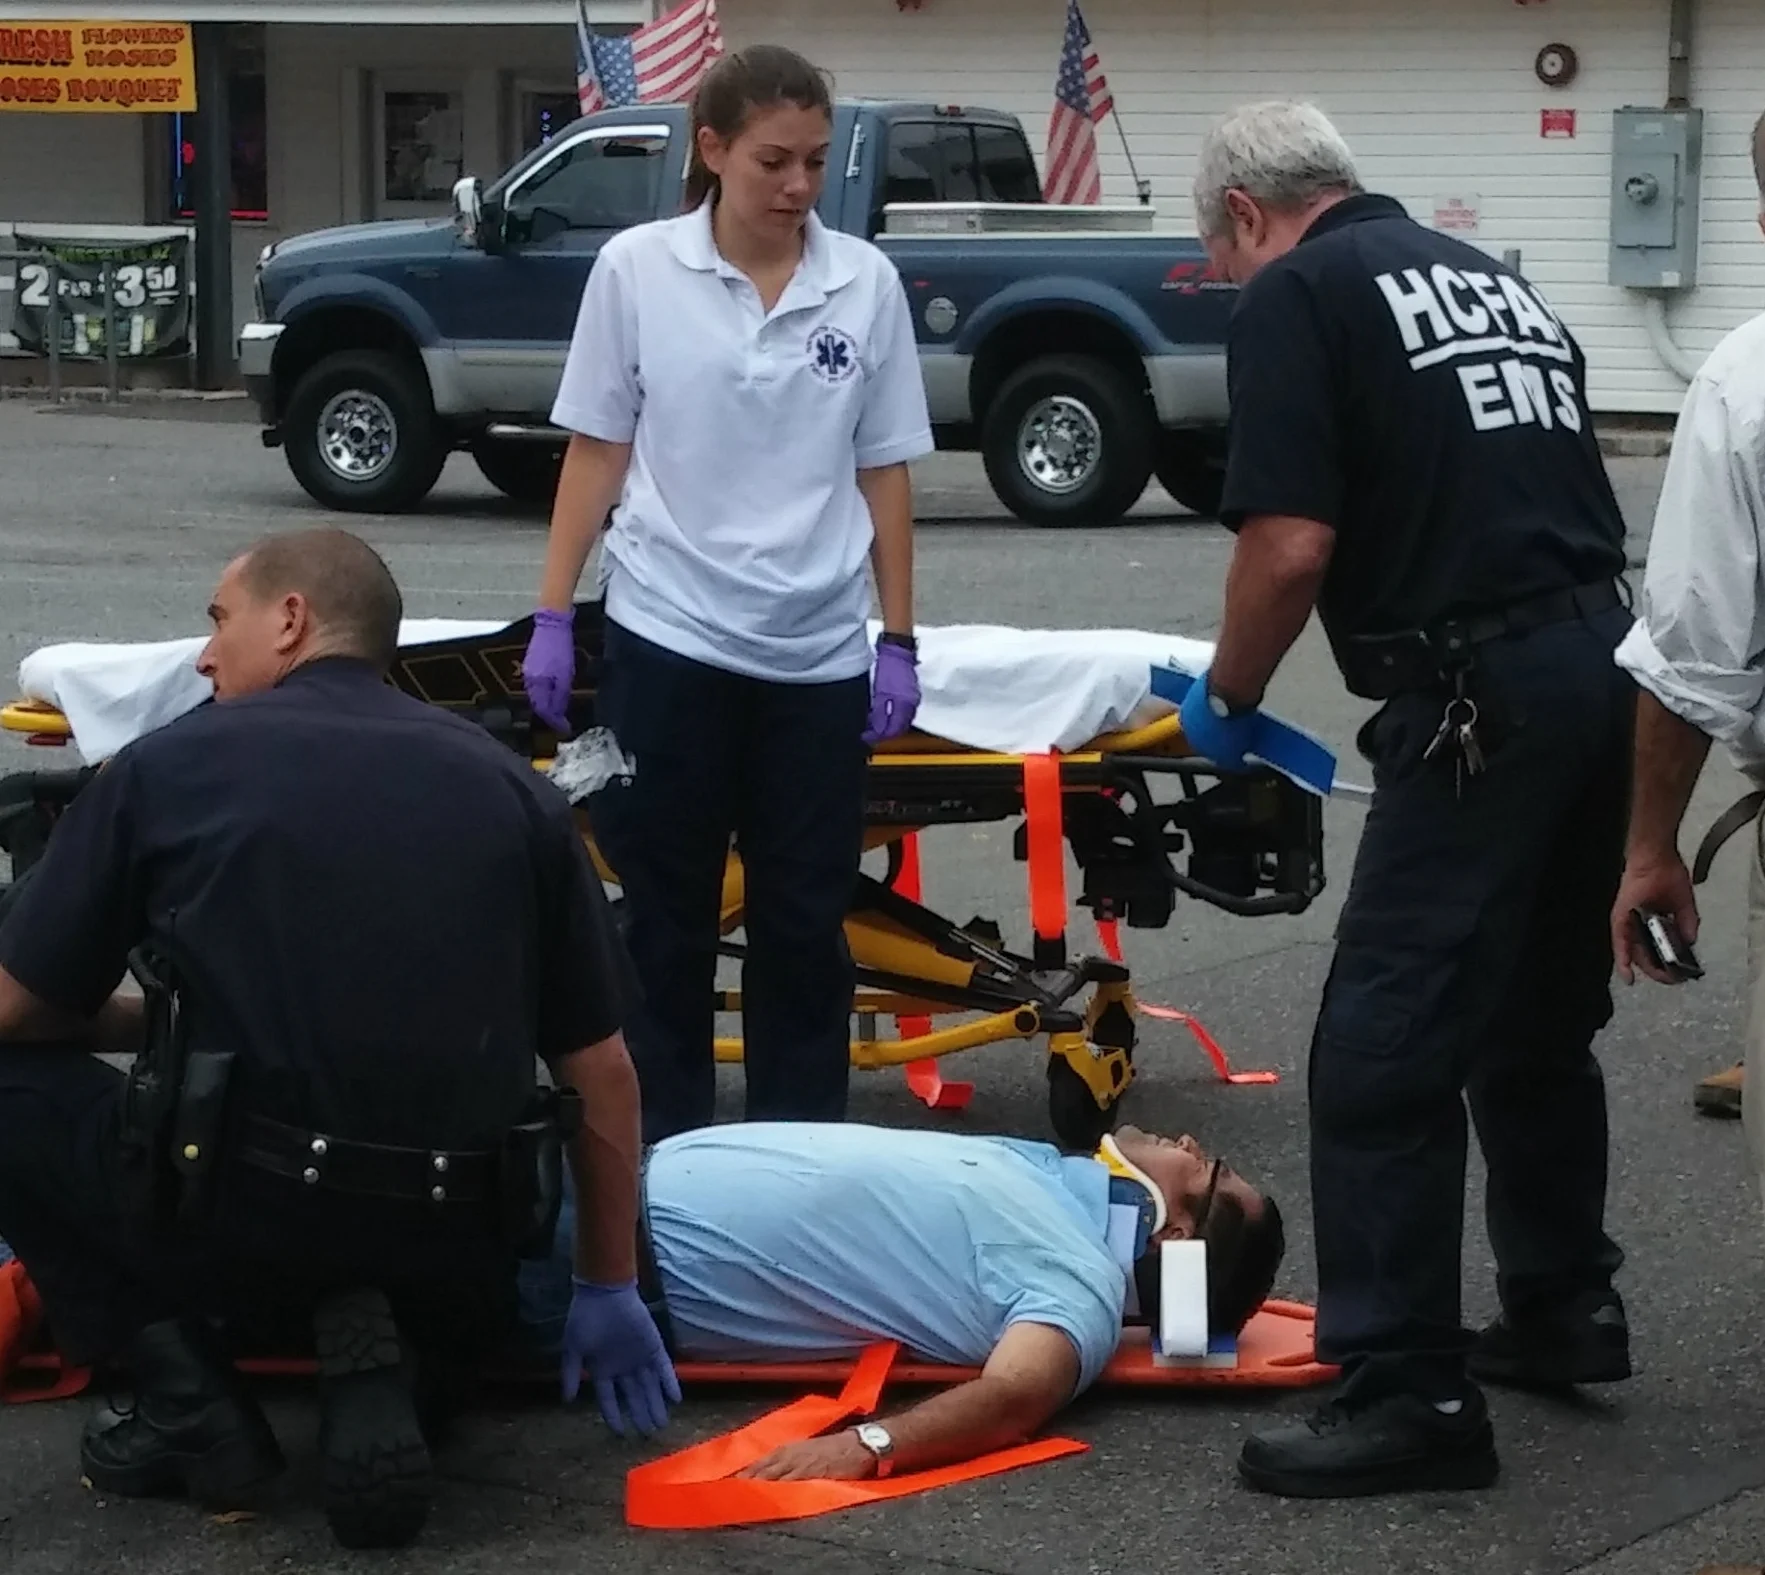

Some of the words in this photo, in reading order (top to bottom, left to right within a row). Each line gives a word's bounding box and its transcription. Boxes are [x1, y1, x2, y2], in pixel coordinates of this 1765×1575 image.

[82, 28, 185, 44] FLOWERS
[85, 49, 177, 67] ROSES
[65, 79, 182, 107] BOUQUET
[20, 264, 50, 306] 2
[1455, 358, 1582, 434] EMS
